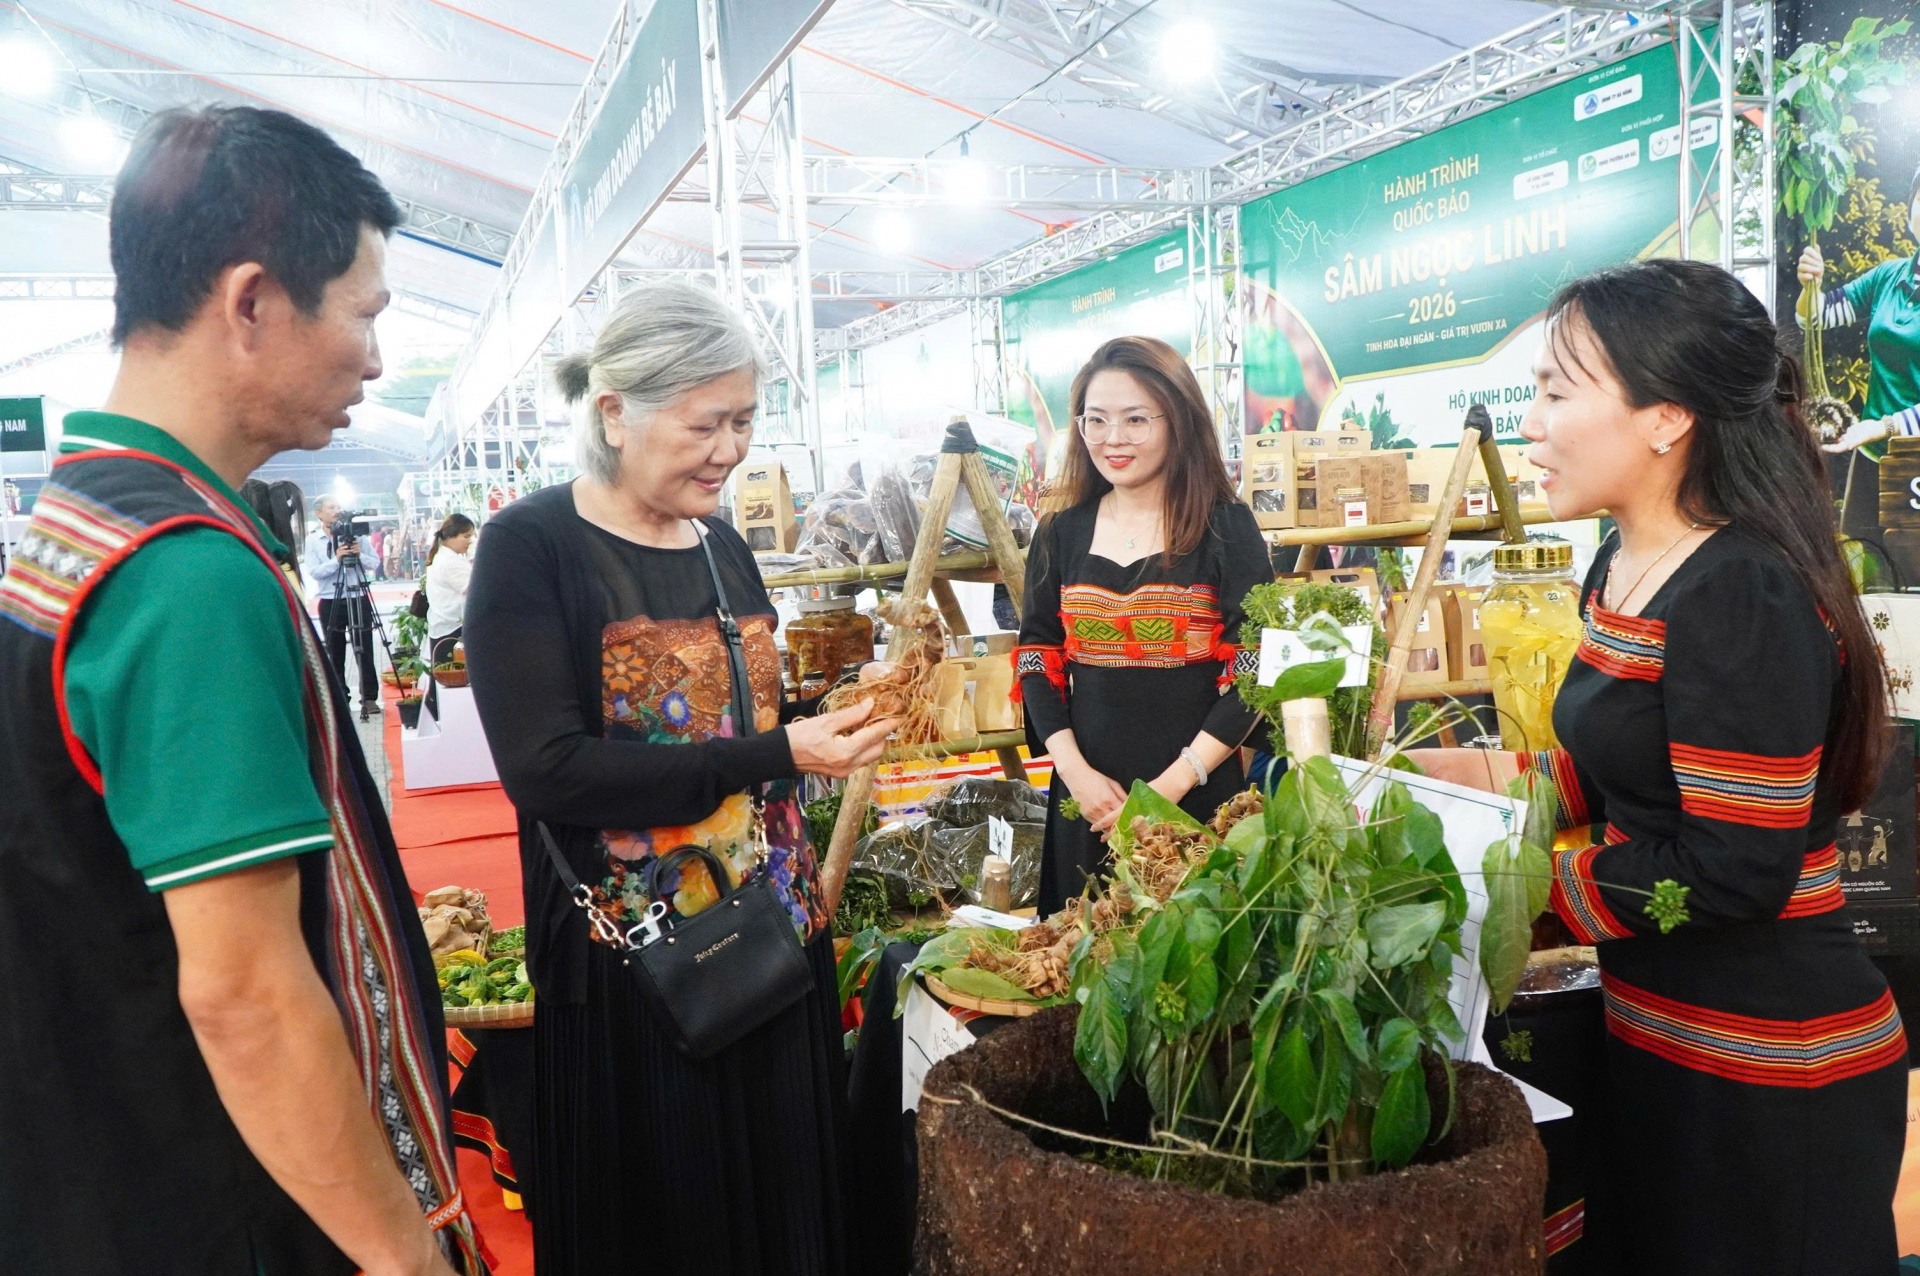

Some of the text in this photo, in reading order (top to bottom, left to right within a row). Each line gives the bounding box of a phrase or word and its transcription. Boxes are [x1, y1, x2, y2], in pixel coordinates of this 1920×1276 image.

[610, 117, 642, 197] DOANH
[654, 57, 677, 133] BẢY
[1384, 153, 1479, 204] HÀNH TRÌNH
[1393, 187, 1470, 233] QUỐC BẢO
[1324, 204, 1567, 303] SÂM NGỌC LINH
[1072, 294, 1092, 314] HÀNH
[1092, 286, 1116, 307] TRÌNH
[1409, 290, 1457, 324] 2026
[1365, 341, 1382, 353] TINH
[1383, 339, 1398, 350] HOA
[1399, 336, 1412, 349] ĐẠI
[1413, 331, 1435, 345] NGÀN
[1440, 325, 1455, 340] GIÁ
[1455, 326, 1469, 338] TRỊ
[1495, 318, 1507, 330] XA
[1449, 389, 1466, 412] HỘ
[1470, 388, 1500, 405] KINH
[4, 418, 27, 432] NAM
[1496, 410, 1523, 434] BẢY
[1547, 592, 1558, 601] 23
[711, 932, 739, 951] Couture
